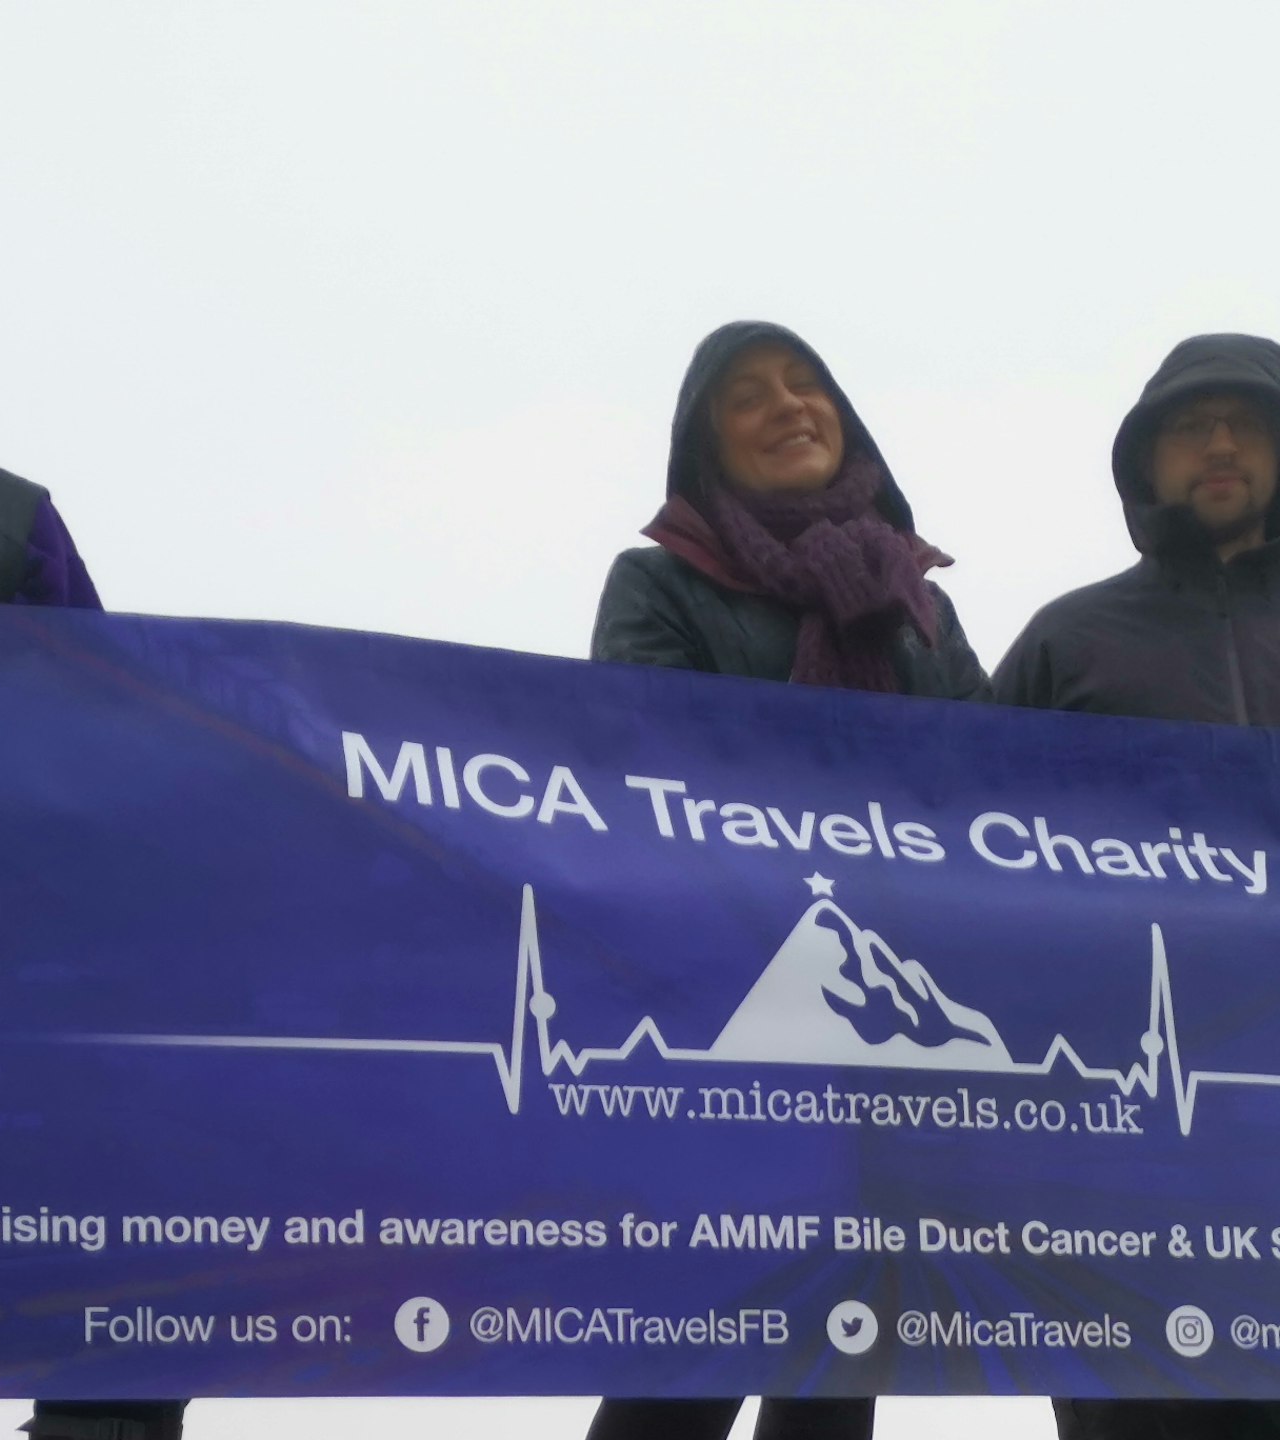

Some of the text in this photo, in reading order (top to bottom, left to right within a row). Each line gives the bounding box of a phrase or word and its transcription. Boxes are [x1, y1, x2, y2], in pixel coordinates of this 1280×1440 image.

[341, 730, 1268, 897] MICA Travels Charity
[548, 1082, 1144, 1135] www.micatravels.co.uk
[122, 1215, 271, 1252] money
[283, 1208, 365, 1246] and
[379, 1217, 608, 1248] awareness
[618, 1212, 678, 1249] for
[688, 1213, 821, 1251] AMMF
[833, 1215, 907, 1253] Bile
[918, 1217, 1011, 1255] Duct
[1021, 1219, 1157, 1258] Cancer
[1167, 1223, 1195, 1259] &
[1204, 1224, 1262, 1260] UK
[84, 1305, 352, 1344] Follow us on:
[469, 1305, 790, 1345] @MICATravelsFB
[896, 1309, 1132, 1349] @MicaTravels
